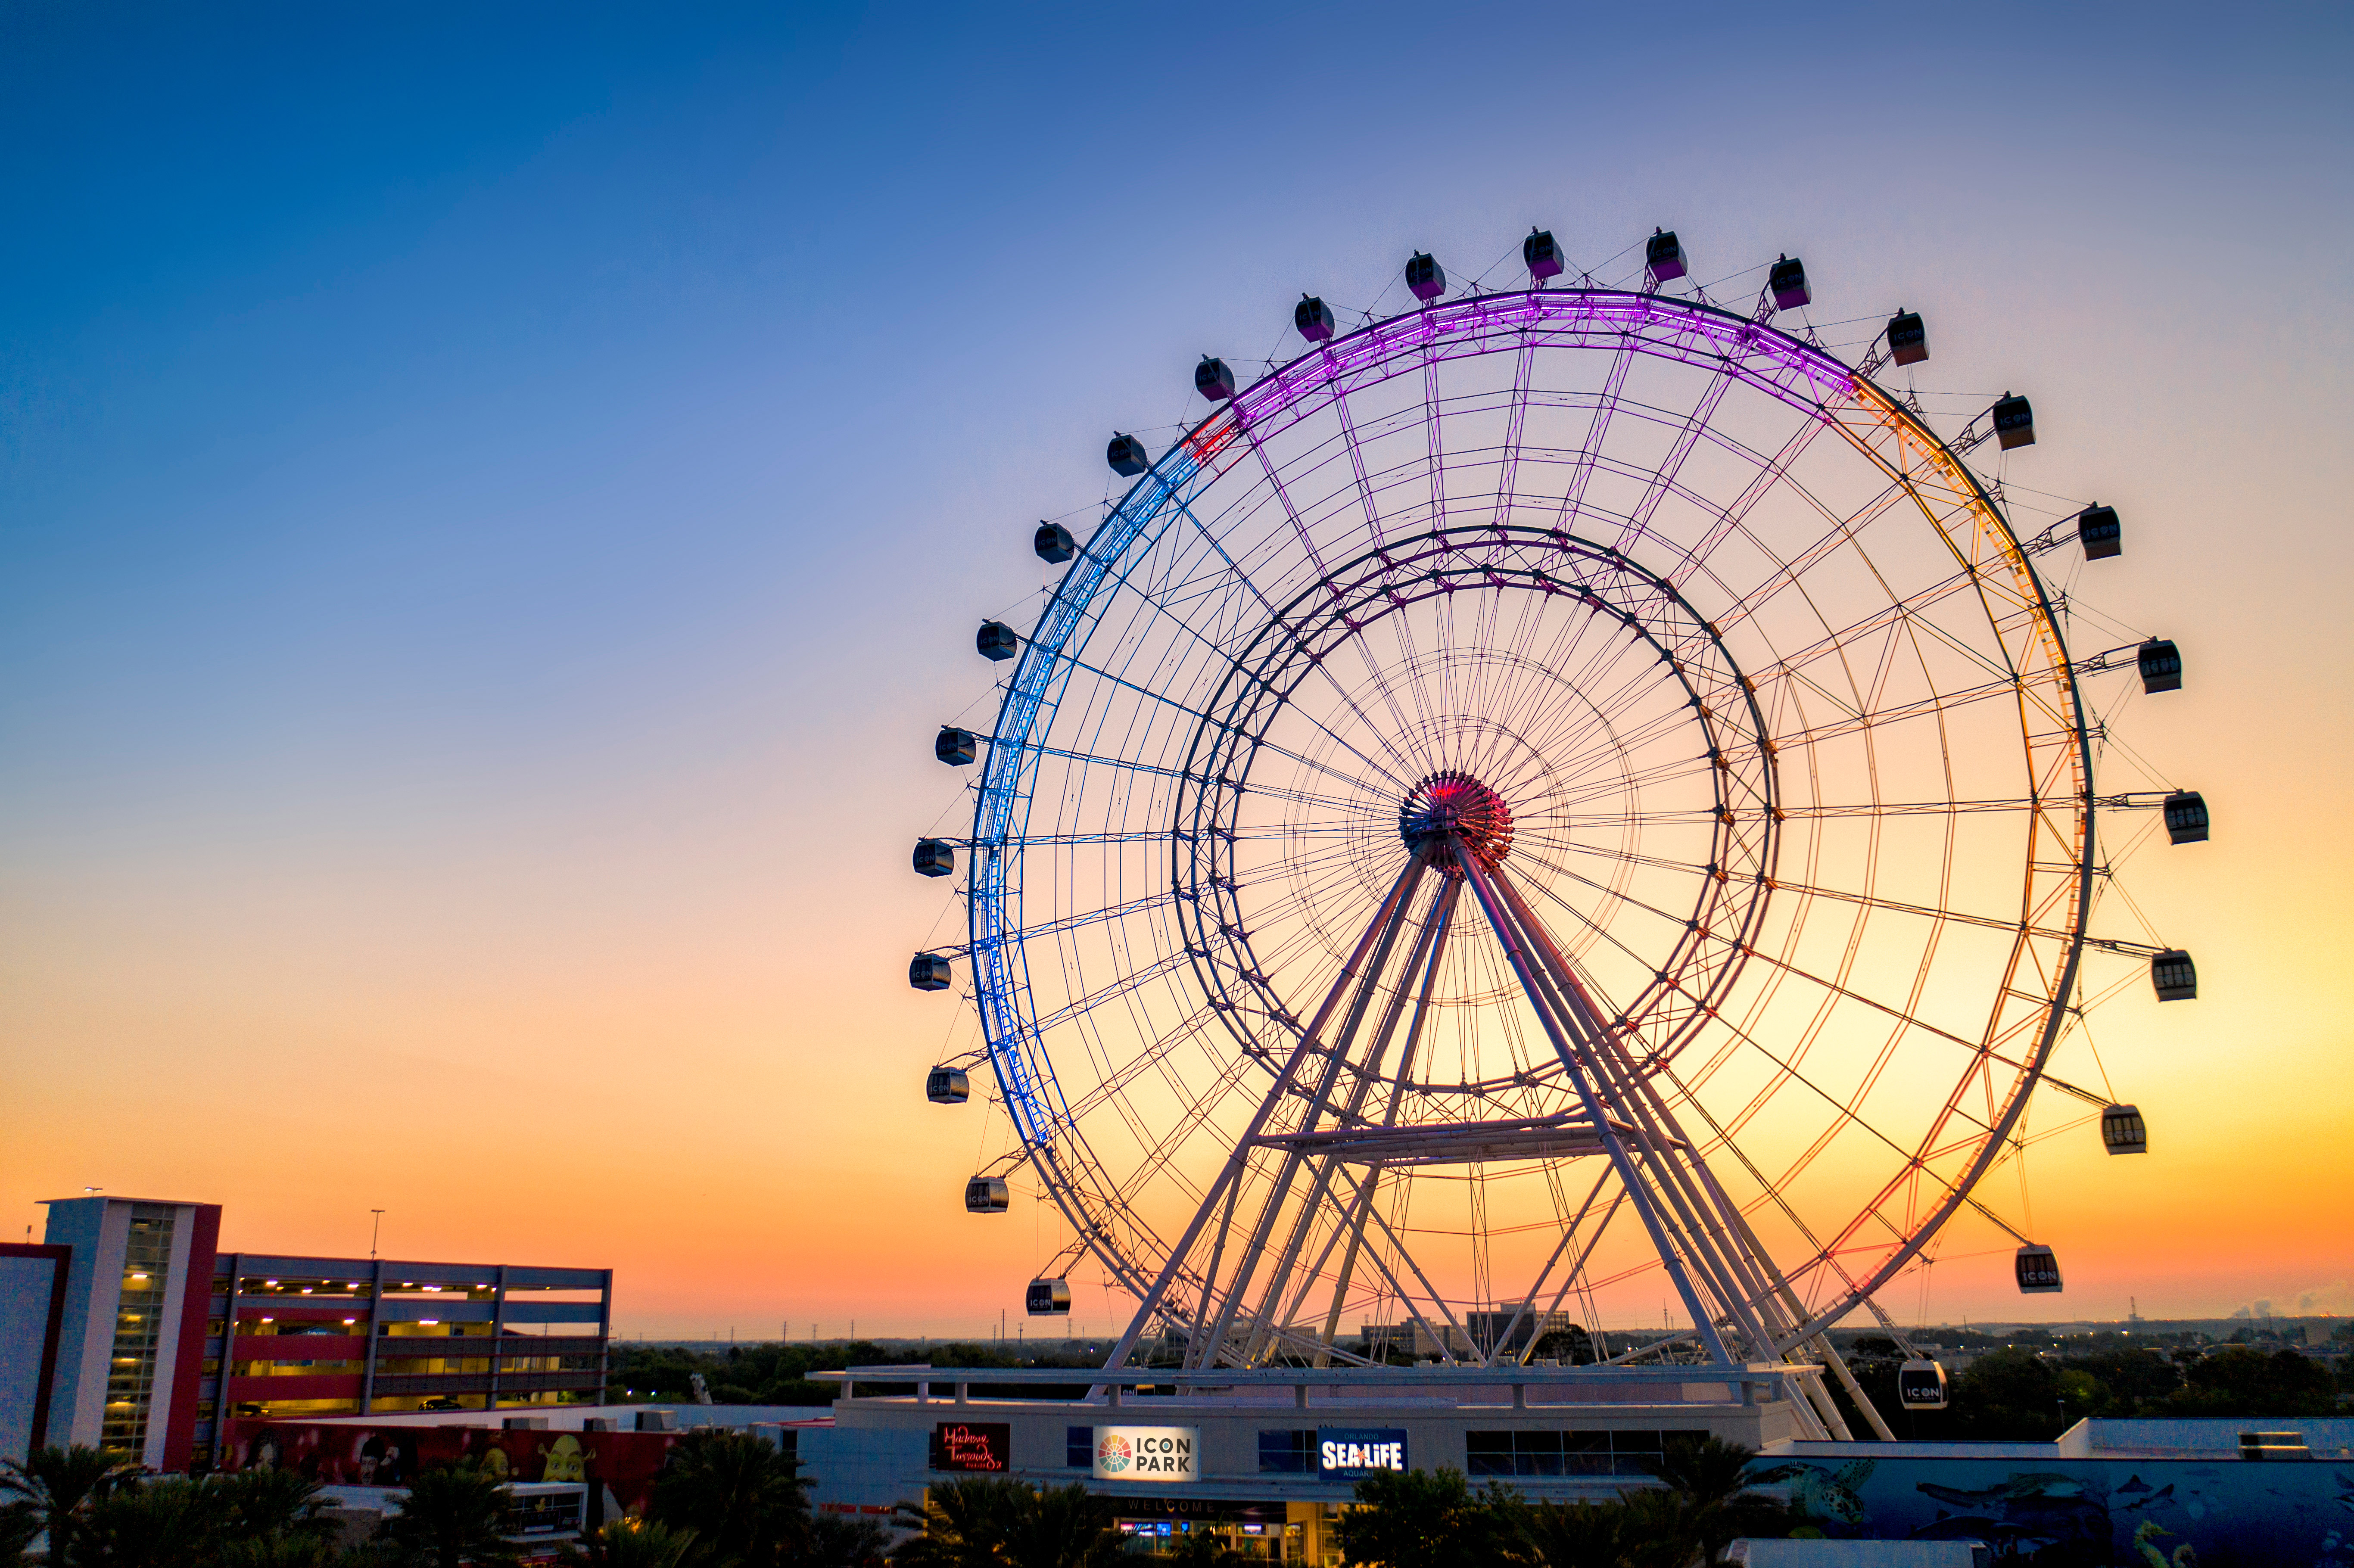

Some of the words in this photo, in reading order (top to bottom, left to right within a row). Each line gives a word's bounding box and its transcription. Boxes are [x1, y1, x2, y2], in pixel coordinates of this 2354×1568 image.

[1776, 273, 1802, 285] ICON
[1894, 328, 1921, 340] ICON
[1999, 412, 2030, 425] ICON
[1038, 537, 1056, 545] ICON
[981, 636, 998, 644] ICON
[2023, 1271, 2056, 1280] ICON
[1907, 1388, 1940, 1397] ICON
[944, 1425, 989, 1444] Madame
[1137, 1437, 1190, 1453] ICON
[1137, 1456, 1190, 1472] PARK
[1128, 1499, 1214, 1512] WELCOME
